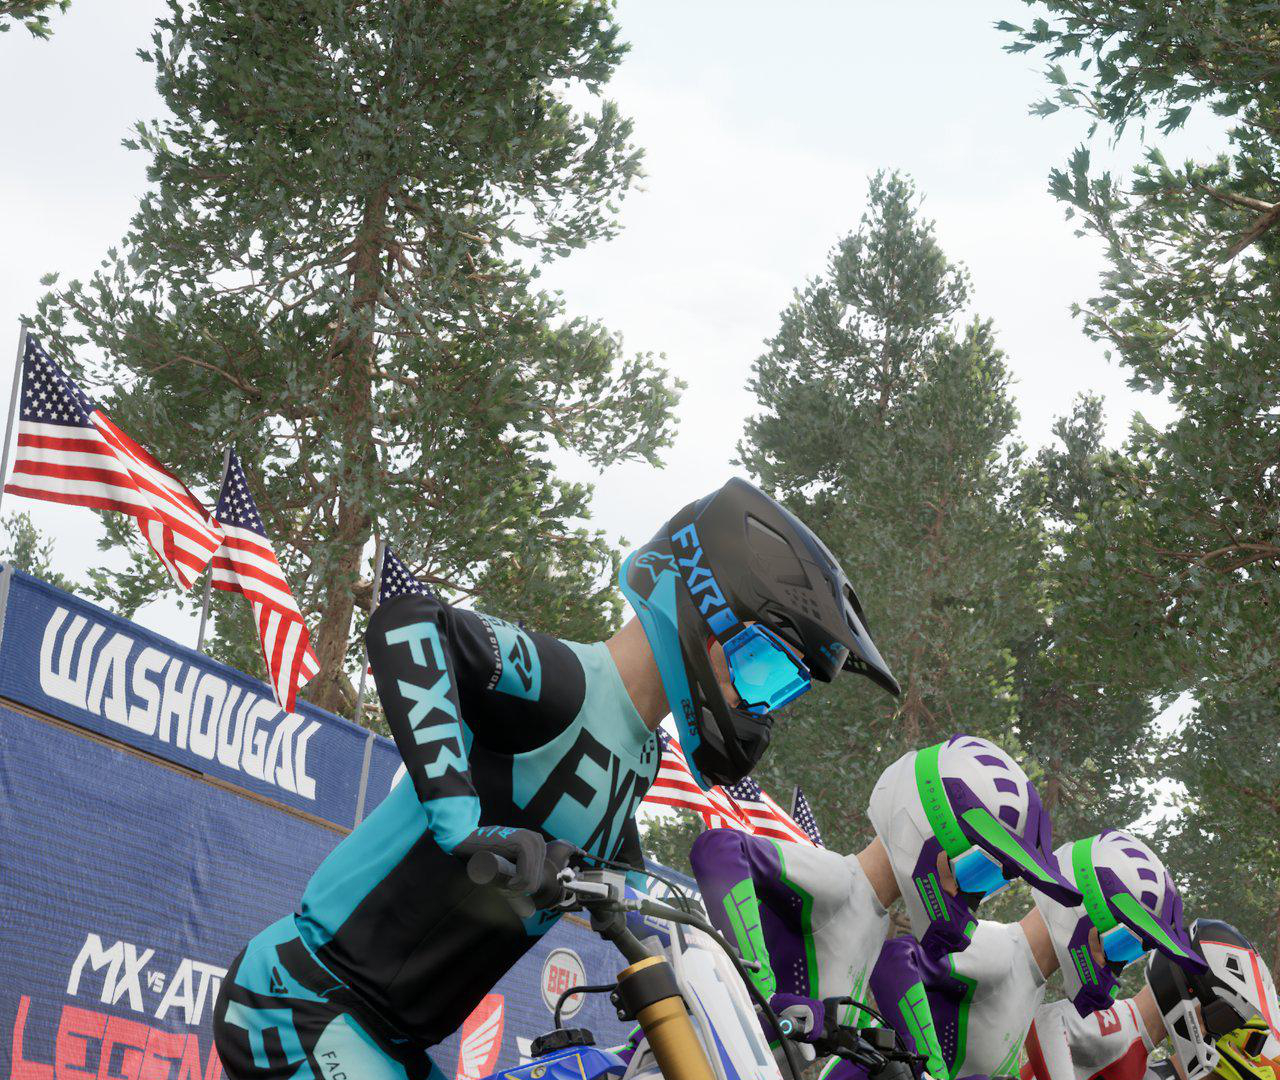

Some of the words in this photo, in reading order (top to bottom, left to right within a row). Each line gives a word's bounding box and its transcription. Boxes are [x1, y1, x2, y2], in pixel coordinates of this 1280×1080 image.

[671, 523, 728, 616] FXR
[40, 606, 322, 801] WASHOUGAL
[384, 621, 470, 781] FXR
[66, 932, 156, 1013] MX
[546, 963, 580, 1001] BELL
